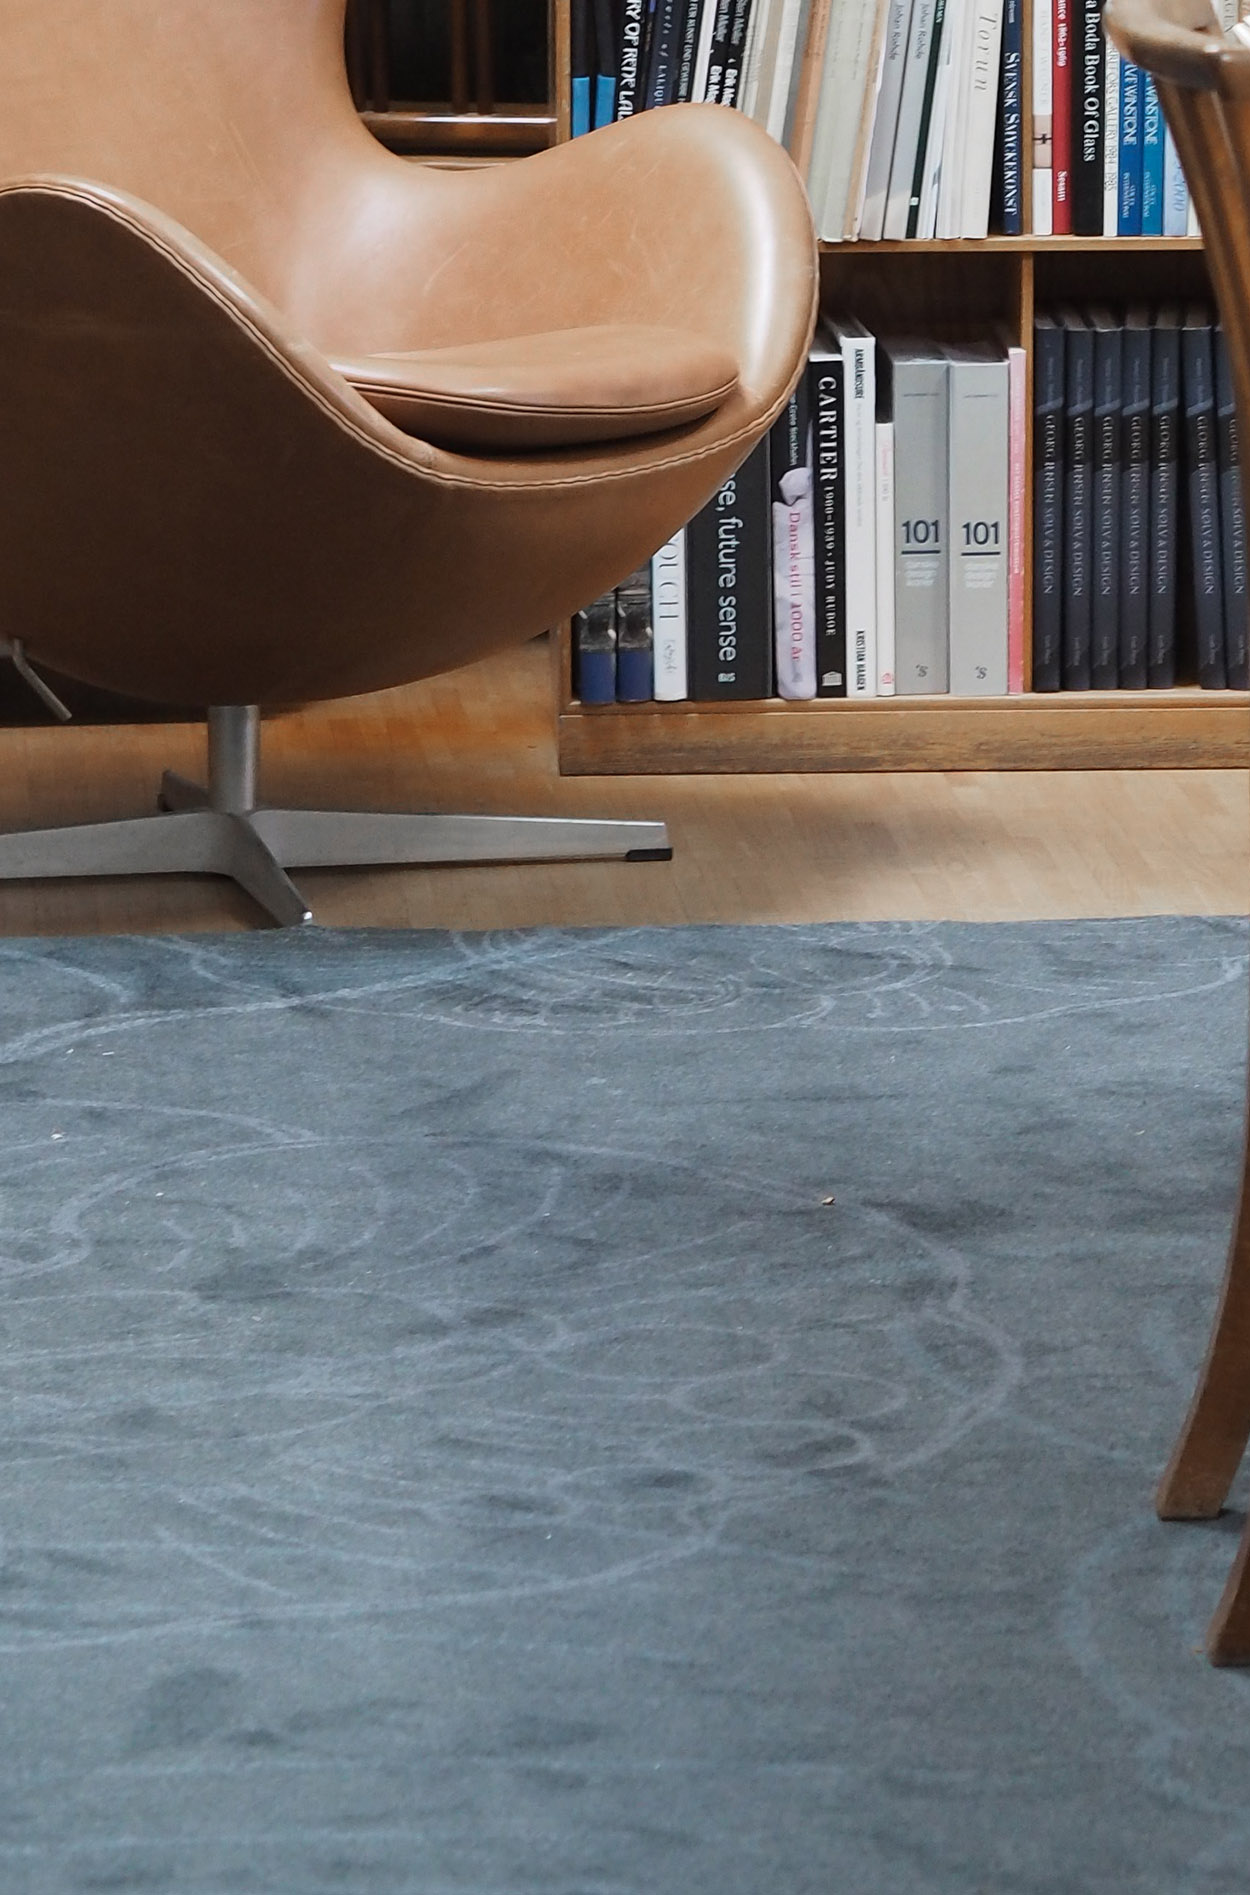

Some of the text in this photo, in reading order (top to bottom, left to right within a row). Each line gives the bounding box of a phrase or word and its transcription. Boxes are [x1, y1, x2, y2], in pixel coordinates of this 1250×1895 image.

[624, 22, 640, 46] OF
[1084, 12, 1101, 51] Boda
[620, 47, 638, 88] RENE
[973, 12, 999, 93] Torun
[1083, 54, 1101, 94] Book
[1084, 99, 1100, 118] Of
[1122, 85, 1137, 145] WINSTONE
[1144, 88, 1158, 145] WINSTONE
[1002, 52, 1021, 216] SVENSK SMYCKEKONST
[1083, 120, 1099, 162] Glass
[1056, 171, 1068, 202] Sesam
[818, 376, 838, 481] CARTIER
[718, 516, 743, 588] future
[788, 512, 802, 560] Dansk
[901, 520, 941, 544] 101
[961, 521, 1001, 546] 101
[789, 563, 803, 588] stil
[824, 559, 837, 590] JUDY
[718, 595, 739, 661] sense
[789, 603, 803, 642] 1000
[825, 595, 837, 636] RUDOE
[791, 646, 803, 662] år
[855, 630, 866, 691] KRISTIAN HAAGEN
